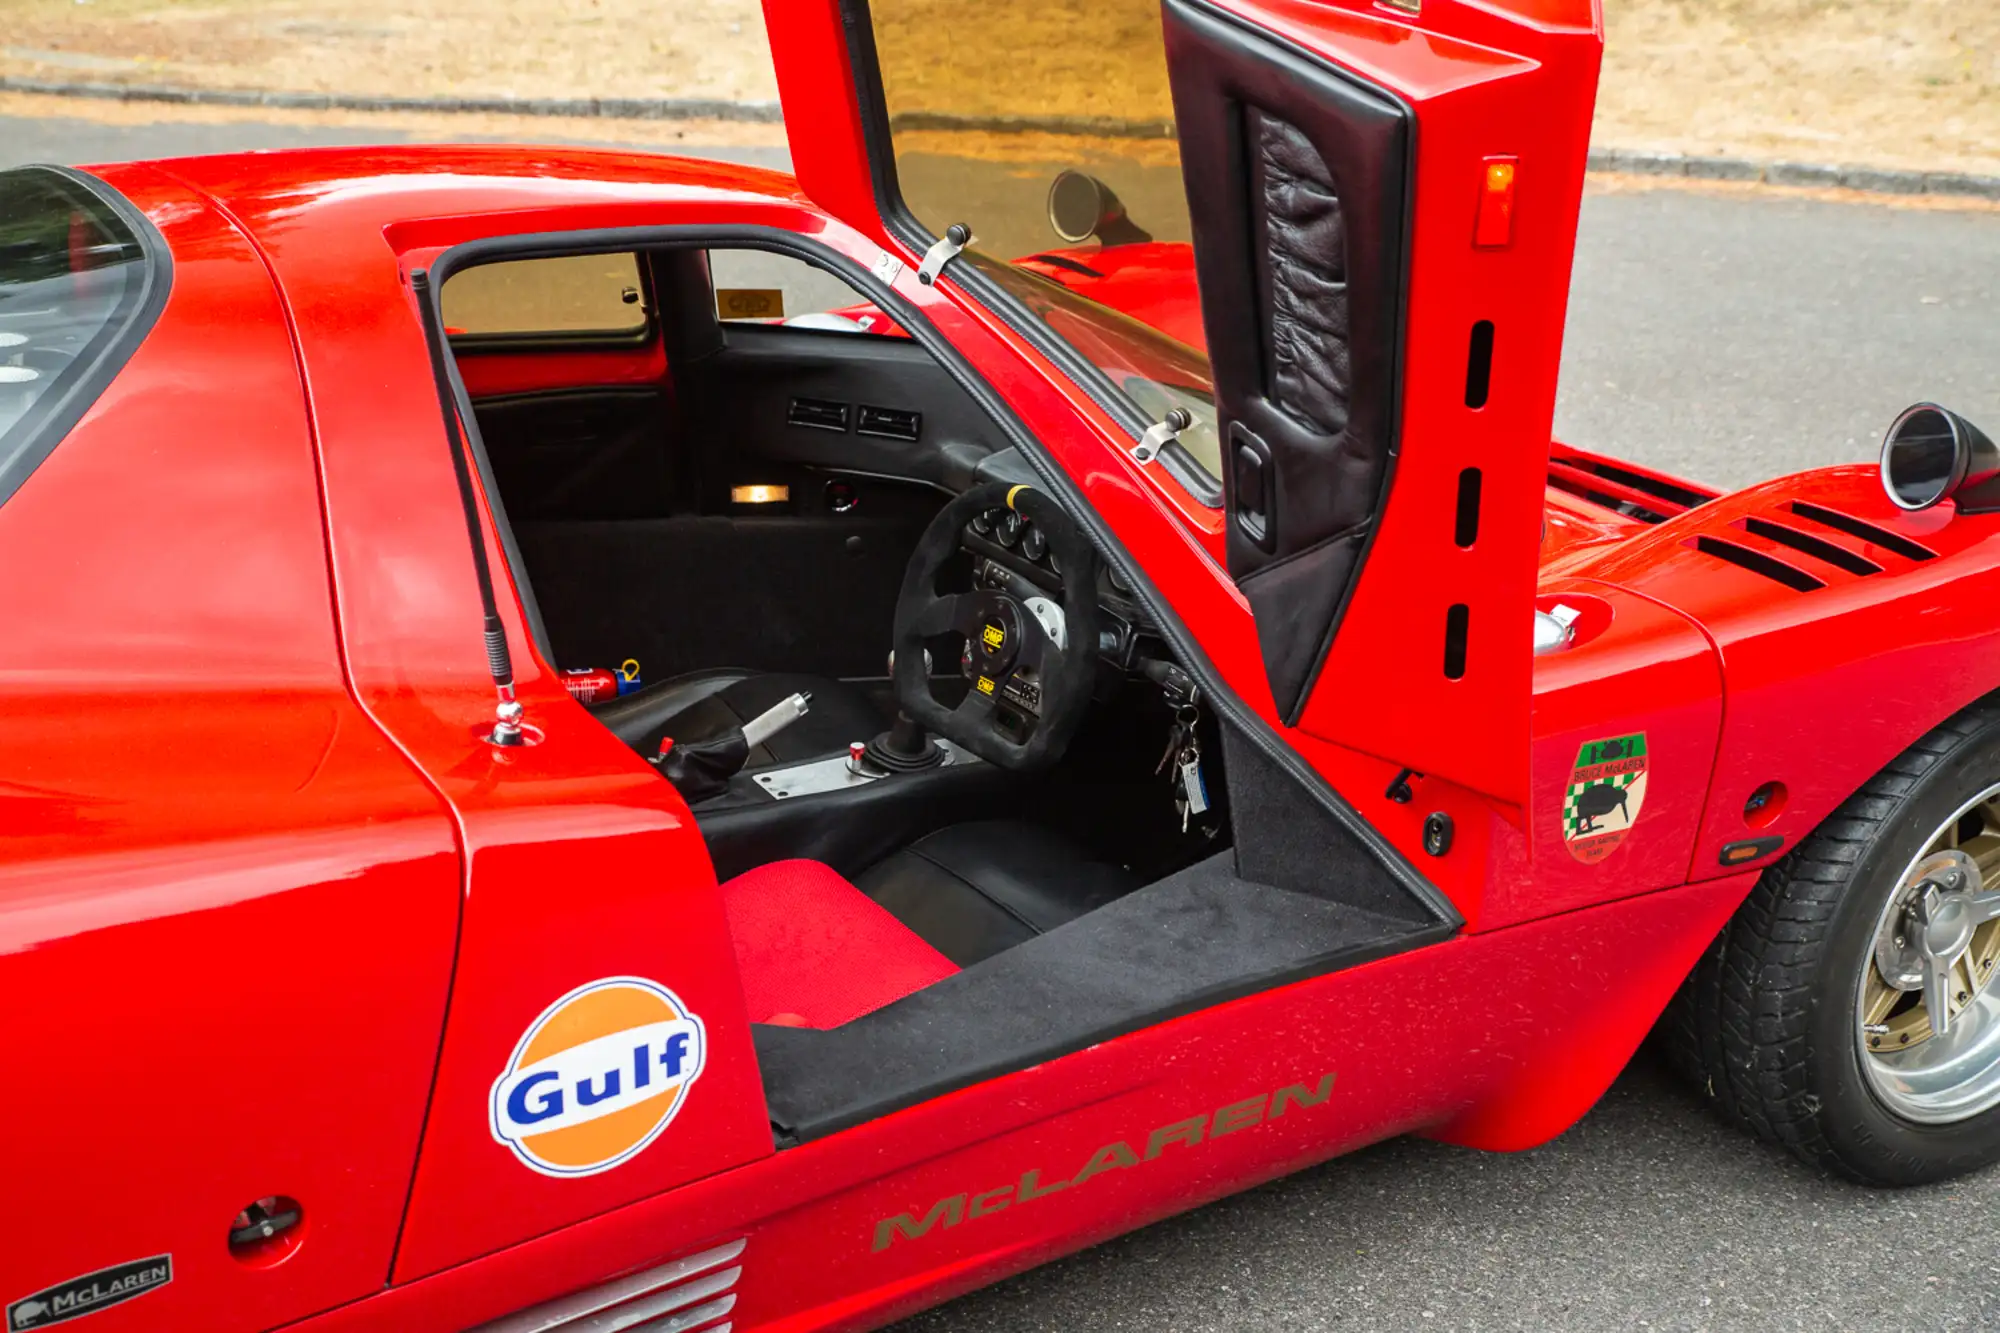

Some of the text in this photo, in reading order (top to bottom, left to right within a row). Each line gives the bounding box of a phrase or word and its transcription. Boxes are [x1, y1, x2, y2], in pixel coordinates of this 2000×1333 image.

[983, 627, 1004, 645] OMP
[1574, 767, 1601, 782] BRUCE
[507, 1032, 689, 1125] Gulf
